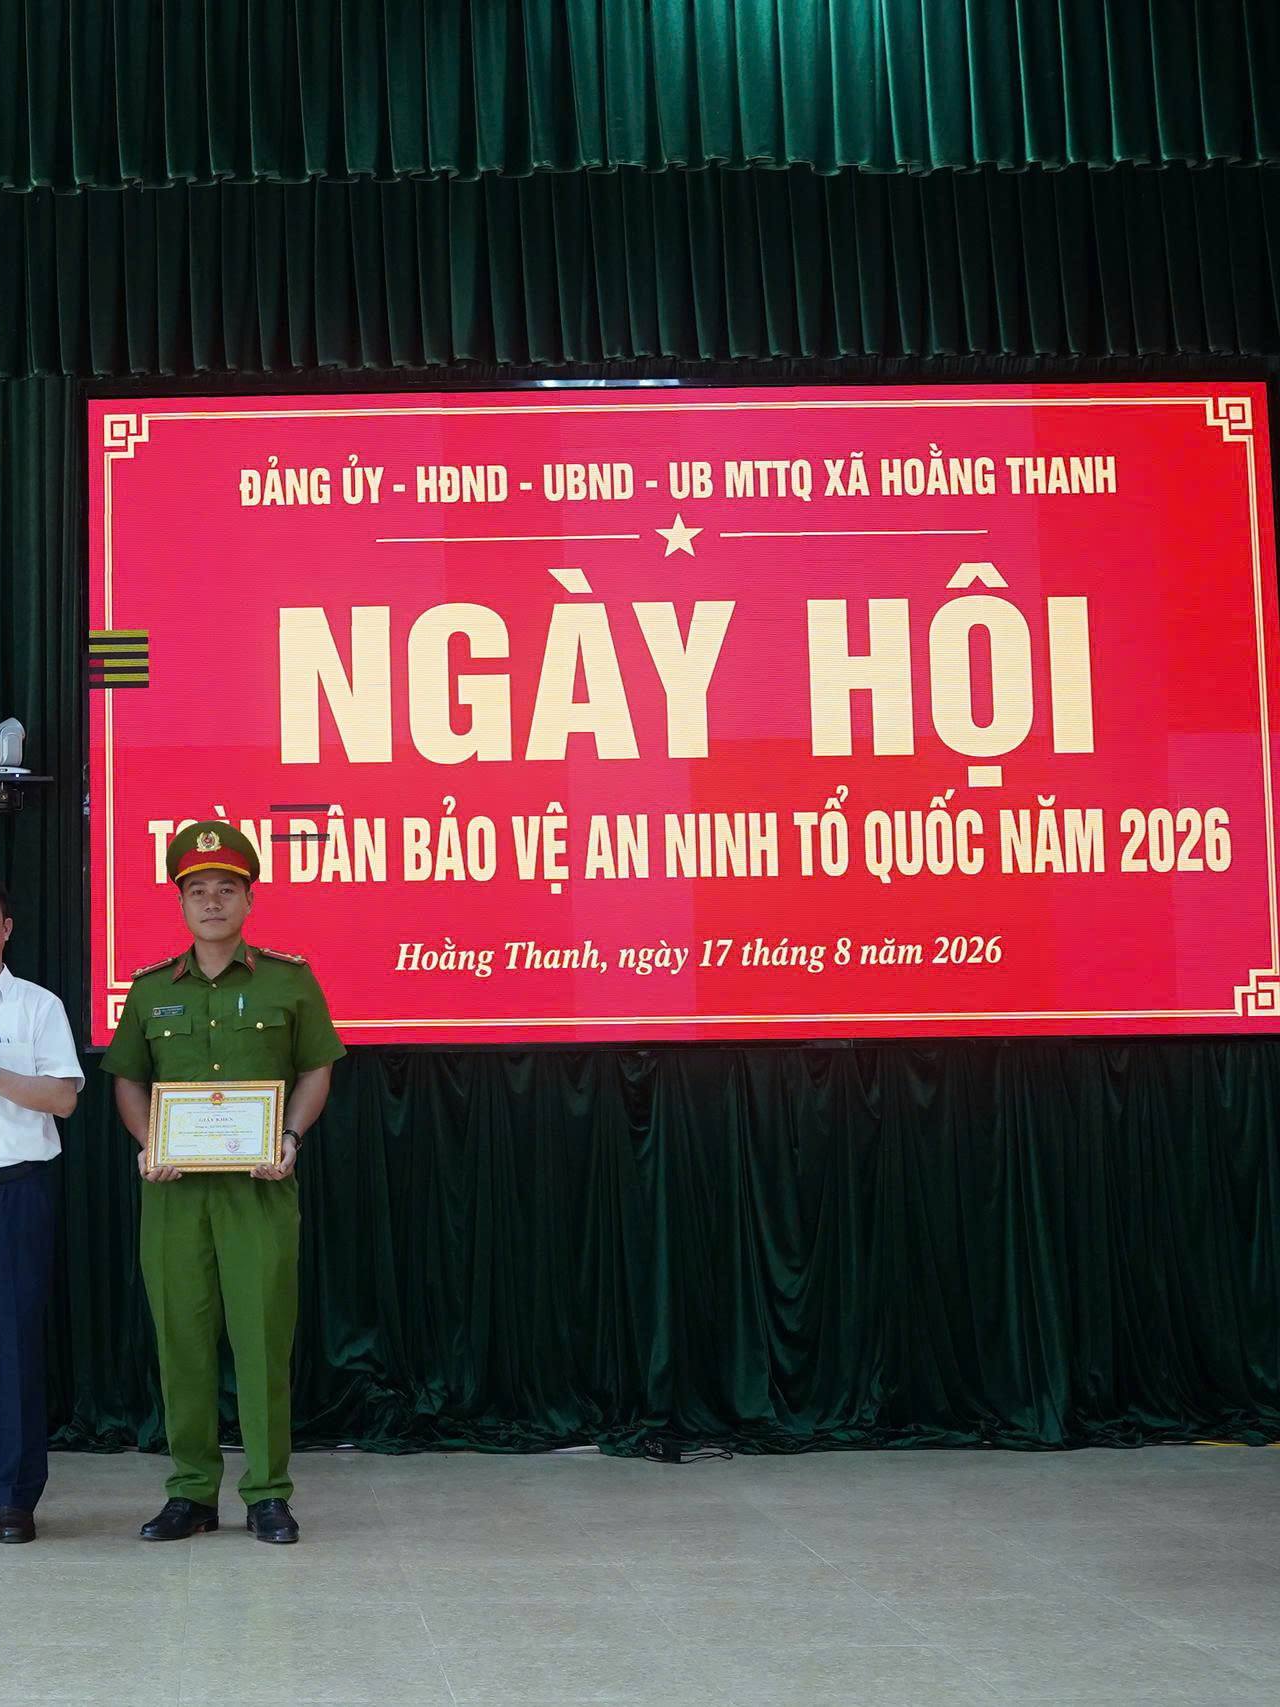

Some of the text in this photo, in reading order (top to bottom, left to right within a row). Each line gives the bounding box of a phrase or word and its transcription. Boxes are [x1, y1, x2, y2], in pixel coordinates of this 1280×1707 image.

[239, 456, 330, 506] ĐẢNG
[343, 454, 385, 505] ỦY
[417, 465, 508, 503] HĐND
[544, 462, 634, 501] UBND
[669, 461, 713, 499] UB
[725, 458, 812, 502] MTTQ
[824, 451, 871, 497] XÃ
[880, 443, 996, 496] HOẰNG
[1005, 455, 1117, 494] THANH
[278, 562, 1095, 788] NGÀY HỘI
[289, 805, 387, 882] DÂN
[403, 796, 497, 882] BẢO
[511, 801, 570, 894] VỆ
[585, 813, 650, 880] AN
[665, 812, 779, 878] NINH
[793, 784, 849, 877] TỔ
[864, 789, 985, 884] QUỐC
[999, 794, 1105, 874] NĂM
[1119, 806, 1232, 873] 2026
[395, 936, 1003, 978] Hoằng Thanh, ngày 17 tháng 8 năm 2026
